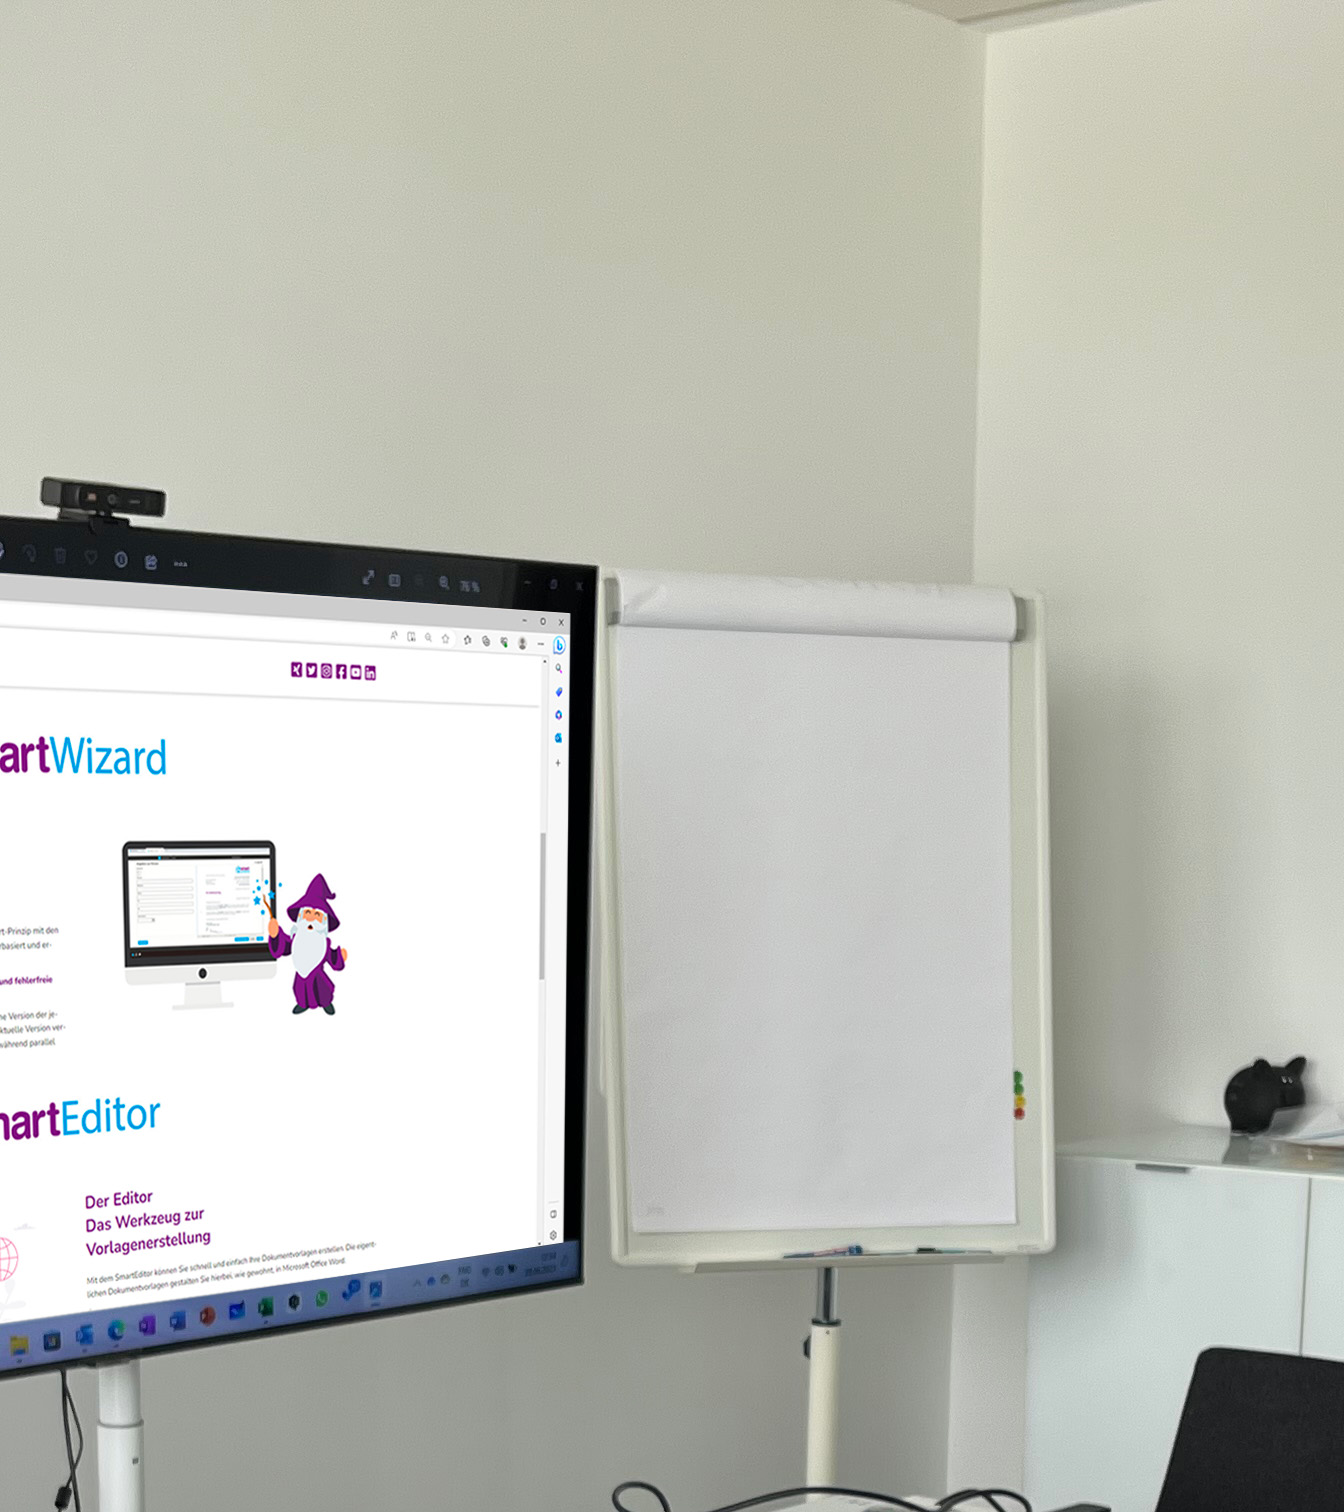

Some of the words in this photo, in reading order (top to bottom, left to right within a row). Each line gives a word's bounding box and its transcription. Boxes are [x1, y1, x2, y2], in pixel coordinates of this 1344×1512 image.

[27, 941, 40, 949] und
[14, 976, 52, 984] fehlerfreie
[36, 1011, 47, 1019] der
[29, 1038, 55, 1048] parallel
[86, 1196, 109, 1209] Der
[114, 1191, 152, 1206] Editor
[86, 1219, 111, 1232] Das
[115, 1213, 180, 1228] Werkzeug
[185, 1210, 204, 1221] zur
[86, 1232, 210, 1256] Vorlagenerstellung
